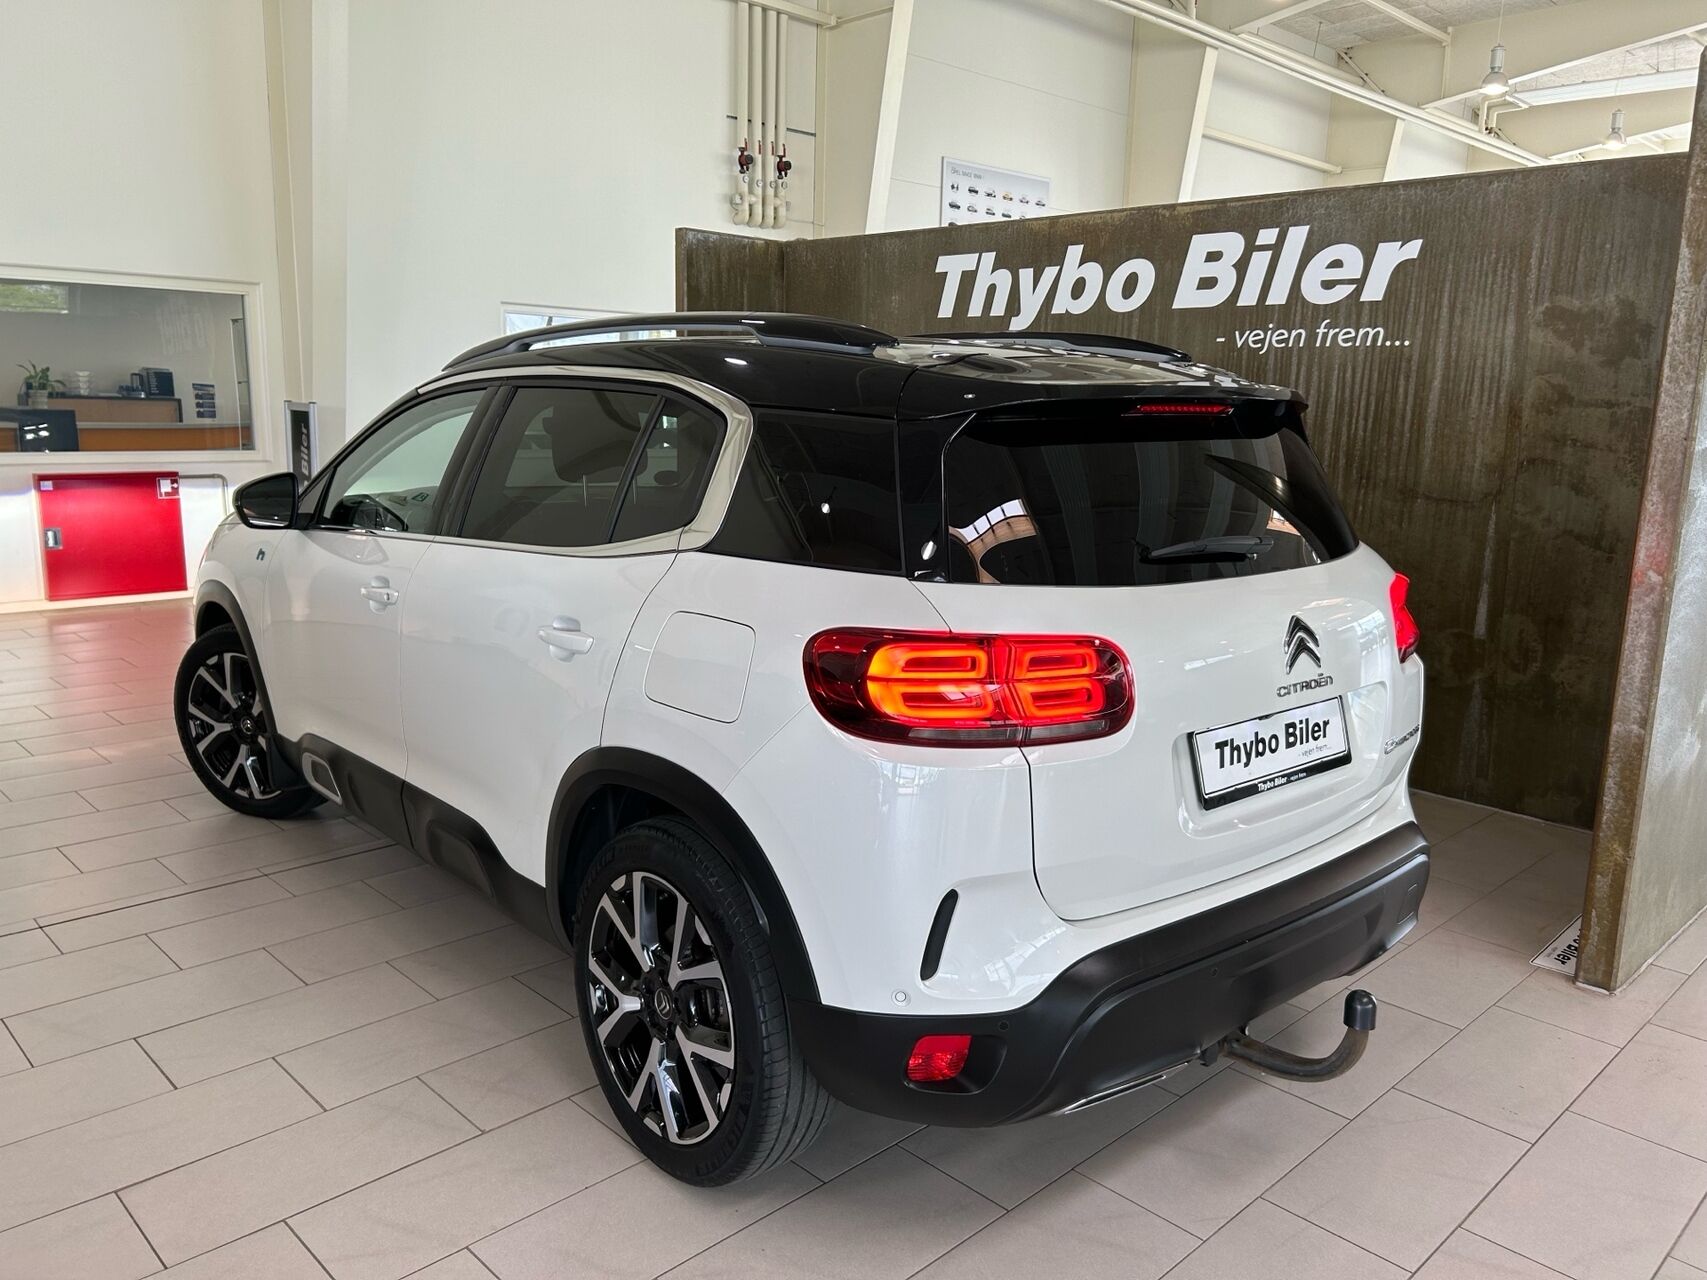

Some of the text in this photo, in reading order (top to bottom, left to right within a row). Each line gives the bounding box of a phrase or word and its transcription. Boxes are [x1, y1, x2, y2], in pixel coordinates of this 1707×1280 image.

[934, 225, 1424, 331] Thybo Biler
[1234, 323, 1306, 355] vejen
[1315, 319, 1411, 348] frem...
[301, 423, 309, 477] Biler
[1215, 718, 1330, 769] Thybo Biler
[1257, 780, 1274, 791] Thybo
[1275, 775, 1288, 786] Biler
